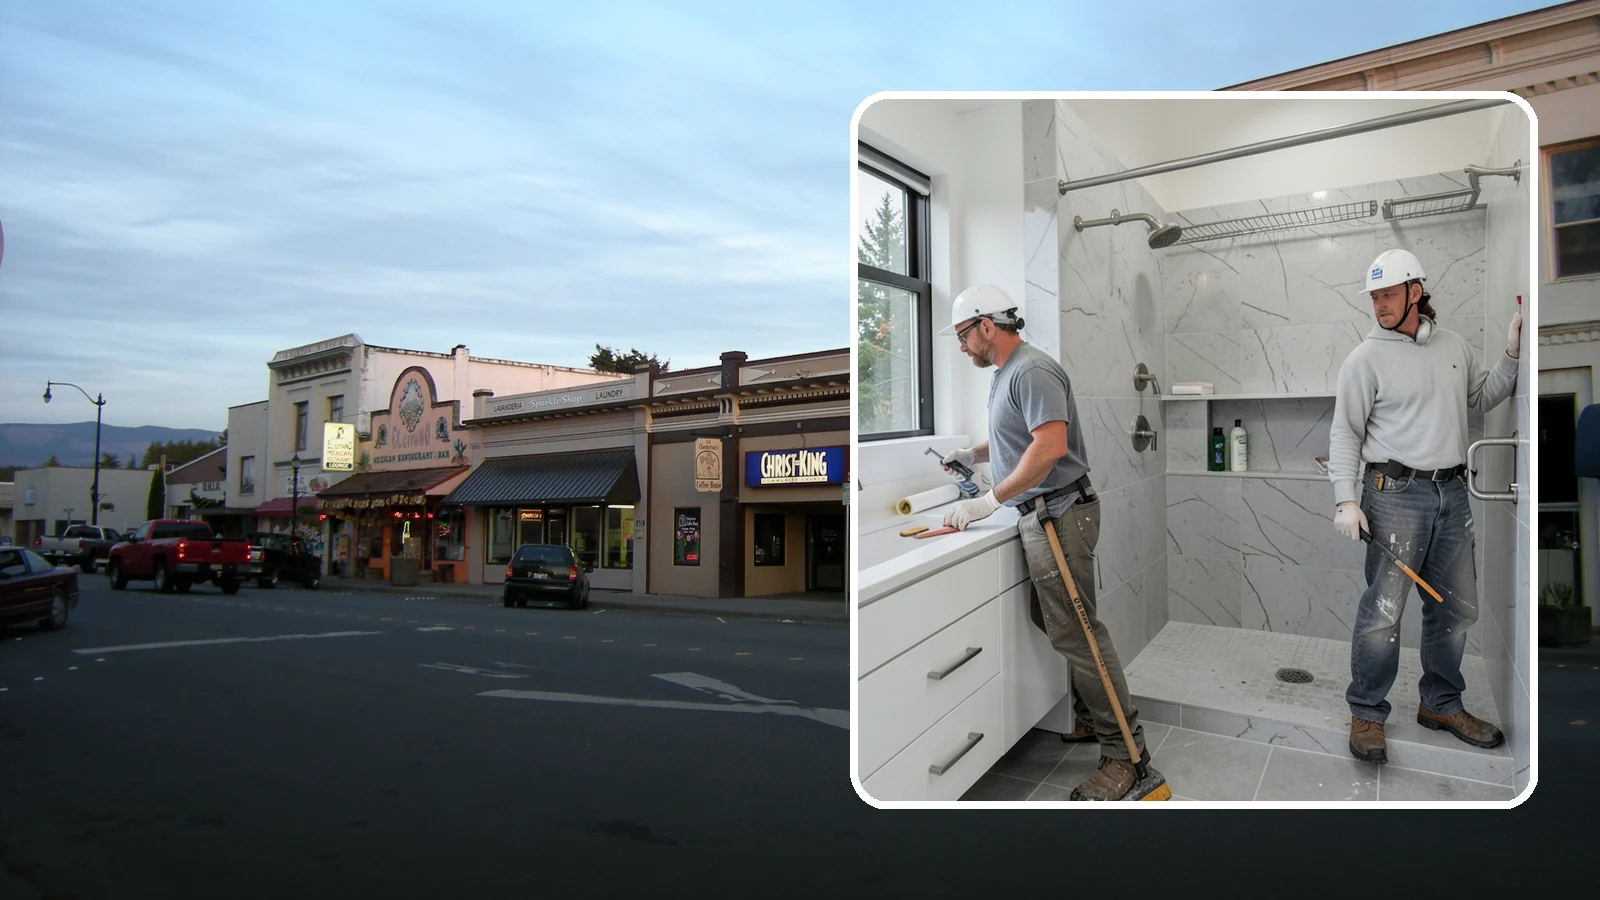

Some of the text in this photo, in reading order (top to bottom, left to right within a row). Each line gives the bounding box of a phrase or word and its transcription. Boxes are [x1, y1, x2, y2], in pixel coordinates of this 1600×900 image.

[561, 394, 583, 404] Shop
[595, 388, 624, 400] LAUNDRY
[493, 402, 522, 412] LAVANDERIA
[373, 450, 450, 463] MEXICAN RESTAURANT BAR
[760, 450, 828, 478] CHRIST KING
[696, 480, 722, 489] Coffee House
